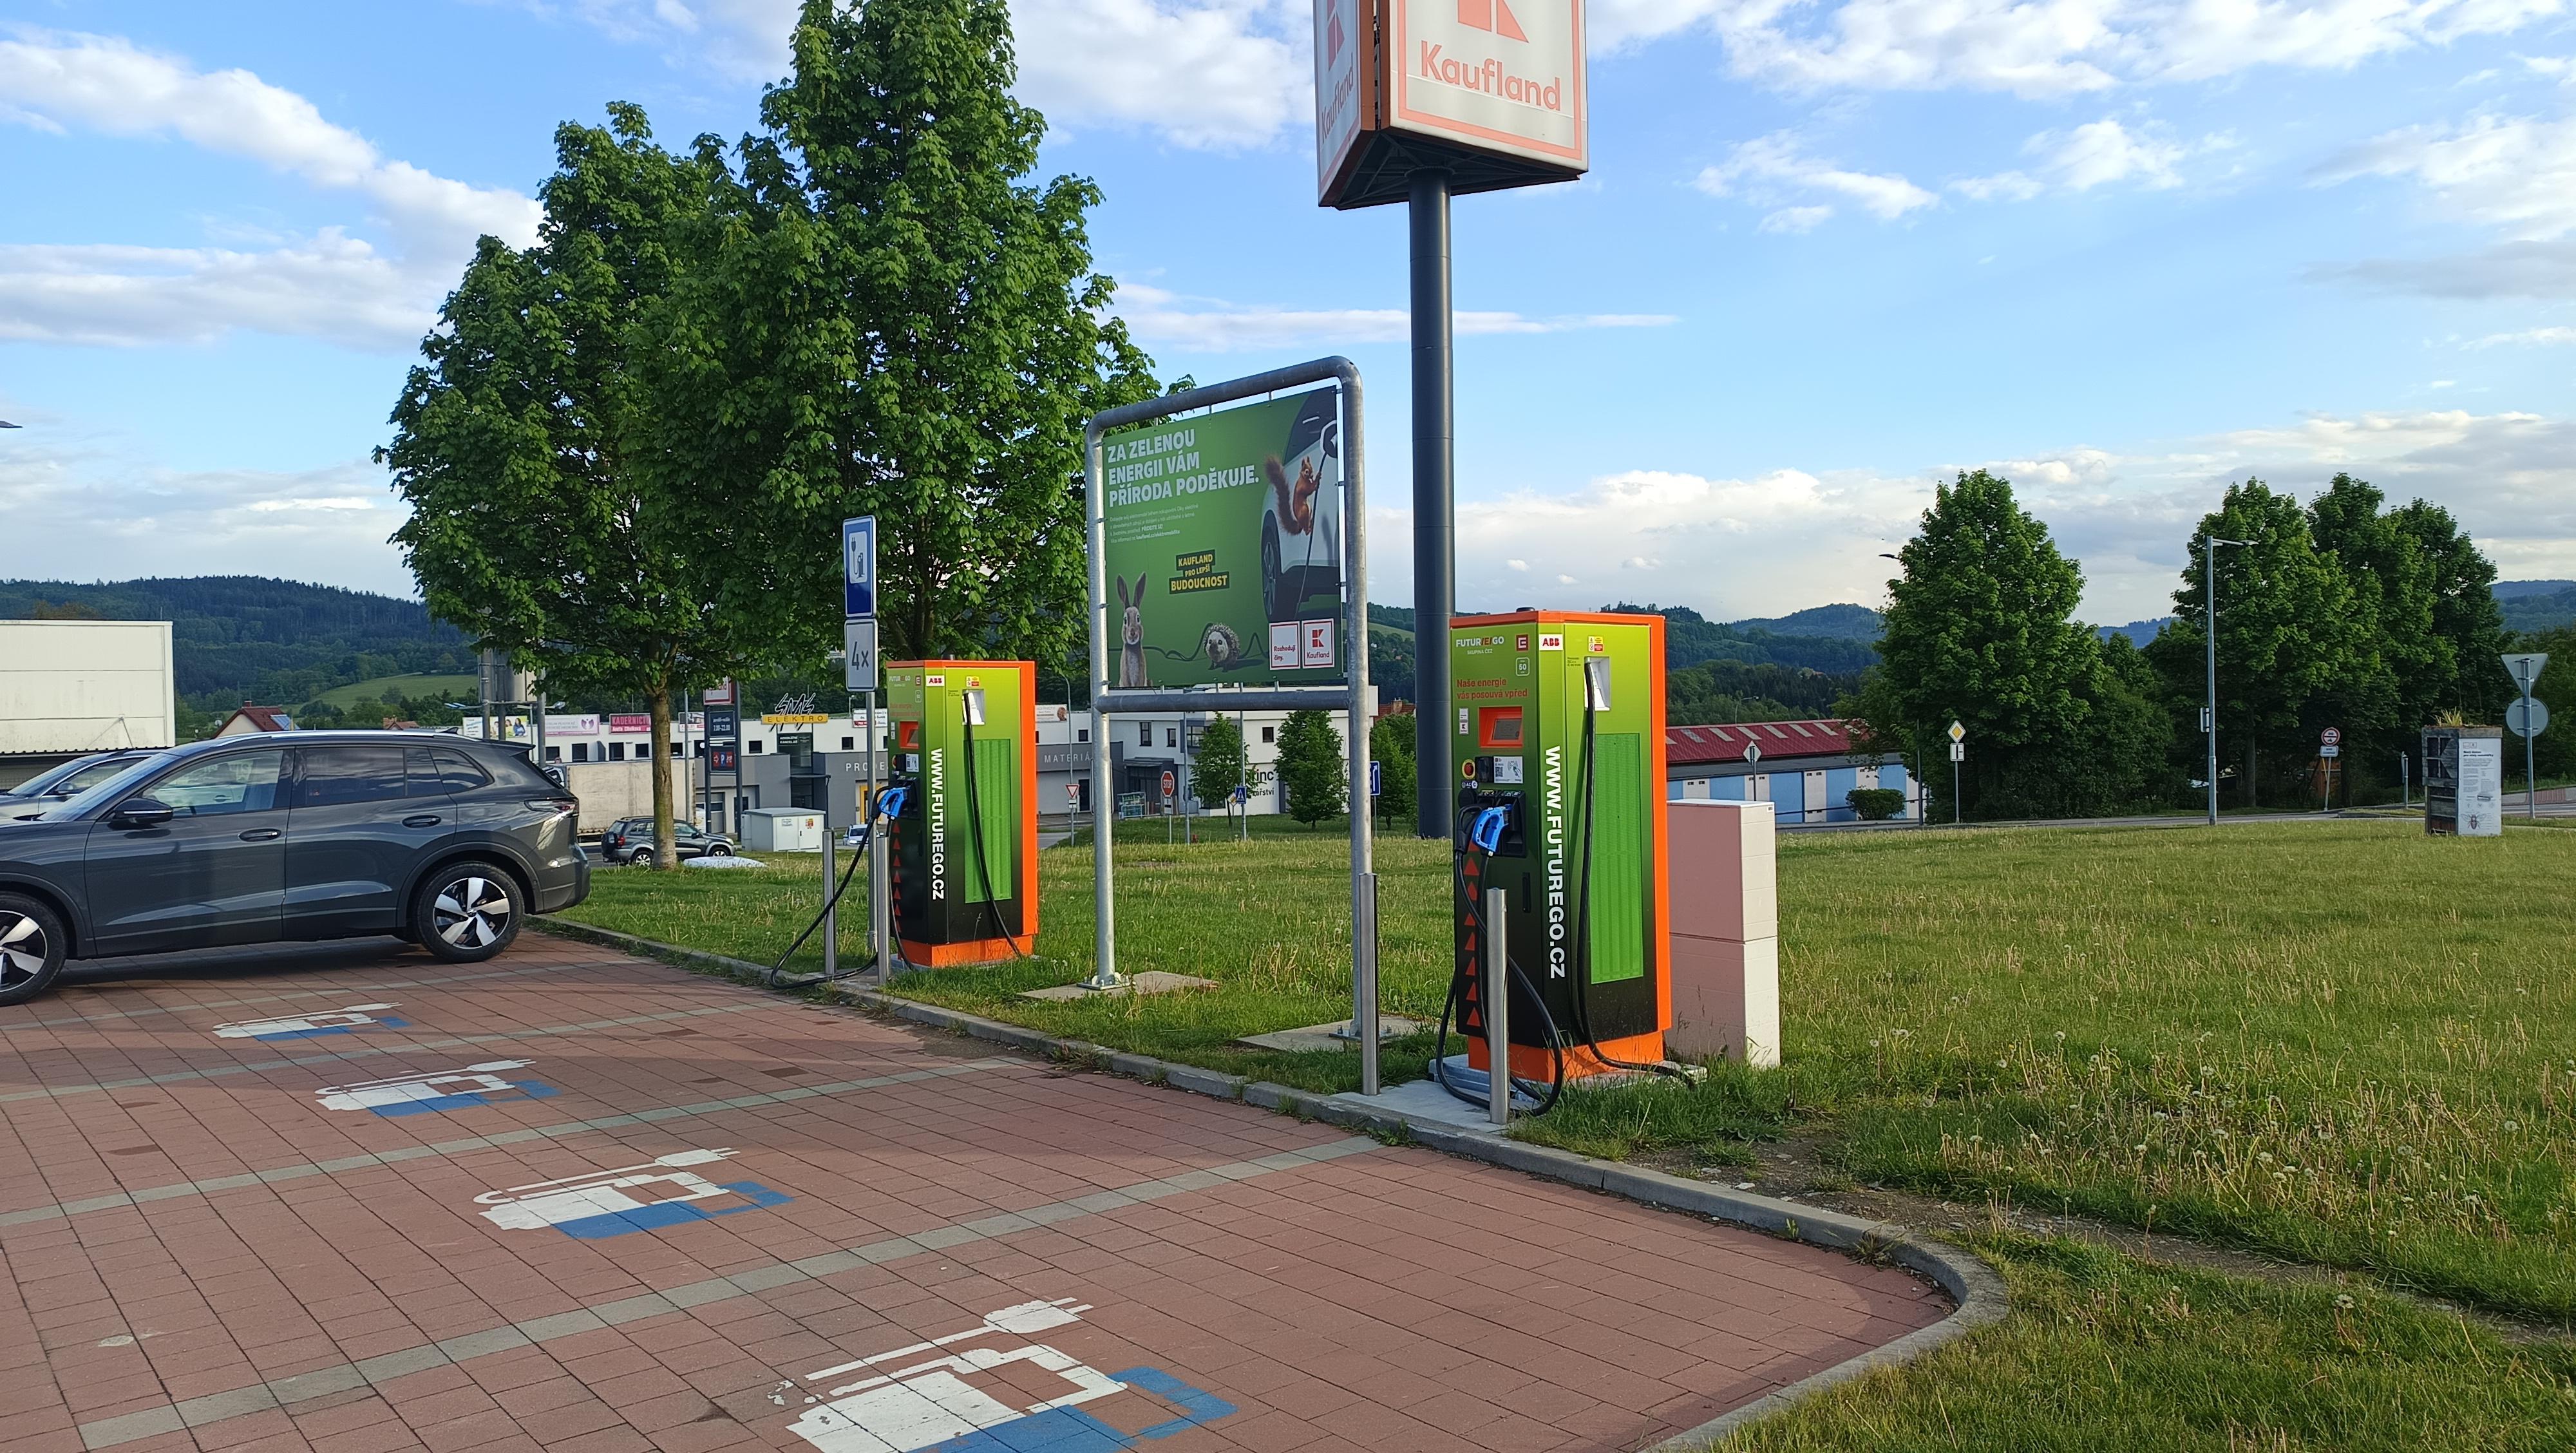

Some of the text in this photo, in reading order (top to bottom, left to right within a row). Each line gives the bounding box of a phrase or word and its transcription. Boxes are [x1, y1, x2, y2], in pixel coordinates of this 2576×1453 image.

[1421, 40, 1561, 111] Kaufland
[1321, 52, 1354, 144] Kaufland
[1107, 428, 1195, 463] ZA ZELENOU
[1108, 448, 1200, 486] ENERGII VÁM
[1108, 465, 1260, 508] PŘÍRODA PODĚKUJE.
[1178, 553, 1213, 567] KAUFLAND
[1196, 565, 1211, 575] LEPŠÍ
[1171, 574, 1228, 591] BUDOUCNOST
[1542, 638, 1560, 647] ABB
[851, 641, 869, 670] 4x
[1457, 678, 1507, 688] Naše energie
[1457, 688, 1528, 700] vás posouvá vpřed
[846, 761, 888, 772] PROE
[1256, 769, 1274, 781] inc
[1163, 779, 1172, 788] STOP
[931, 748, 945, 900] WWW.FUTUREGO.CZ
[1545, 745, 1566, 979] WWW.FUTUREGO.CZ
